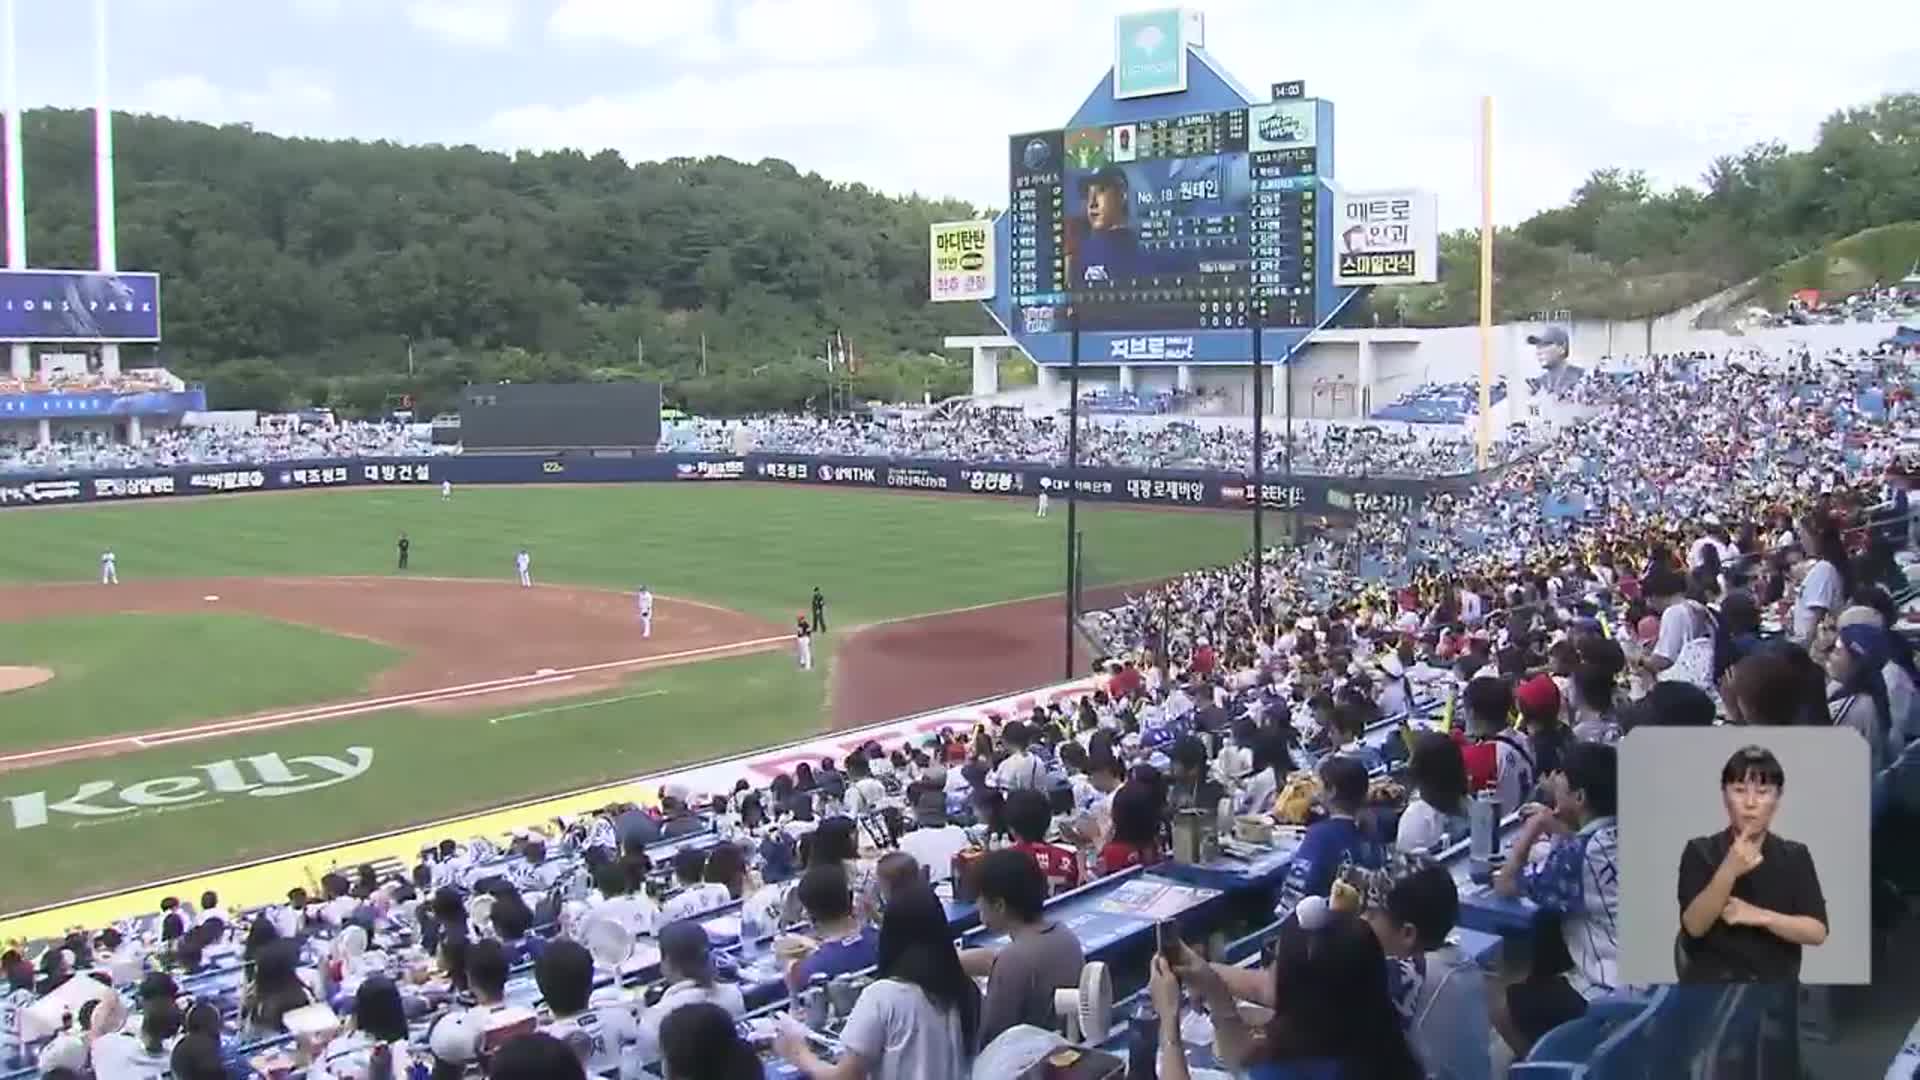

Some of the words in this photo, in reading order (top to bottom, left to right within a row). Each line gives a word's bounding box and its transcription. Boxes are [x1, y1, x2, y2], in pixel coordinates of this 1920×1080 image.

[1180, 179, 1220, 200] 원태인
[1346, 200, 1410, 222] 메트로
[1341, 253, 1413, 275] 스마일라식
[89, 301, 151, 312] PARK
[364, 464, 429, 481] 대방건설
[1127, 478, 1204, 501] 대광로제비앙
[9, 746, 375, 830] Kelly
